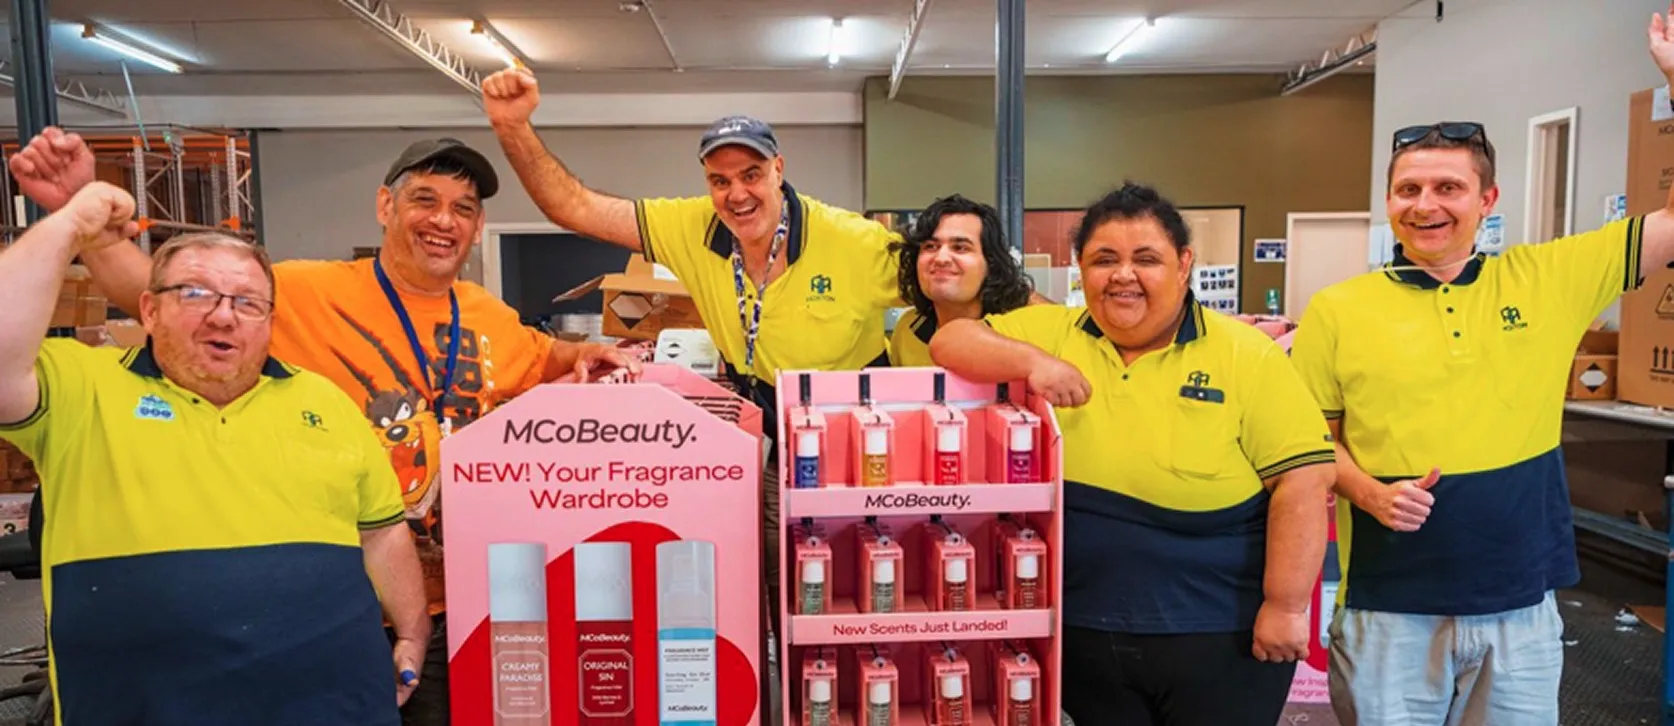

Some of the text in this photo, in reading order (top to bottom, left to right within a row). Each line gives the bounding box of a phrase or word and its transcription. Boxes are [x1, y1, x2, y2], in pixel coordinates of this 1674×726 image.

[503, 419, 697, 448] MCoBeauty.
[453, 461, 744, 486] NEW! Your Fragrance
[530, 489, 669, 509] Wardrobe
[865, 494, 972, 510] MCoBeauty.
[833, 620, 1008, 637] New Scents Just Landed!
[501, 662, 540, 672] CREAMY
[583, 661, 629, 671] ORIGINAL
[499, 673, 544, 682] PARADISE
[598, 672, 615, 682] SIN
